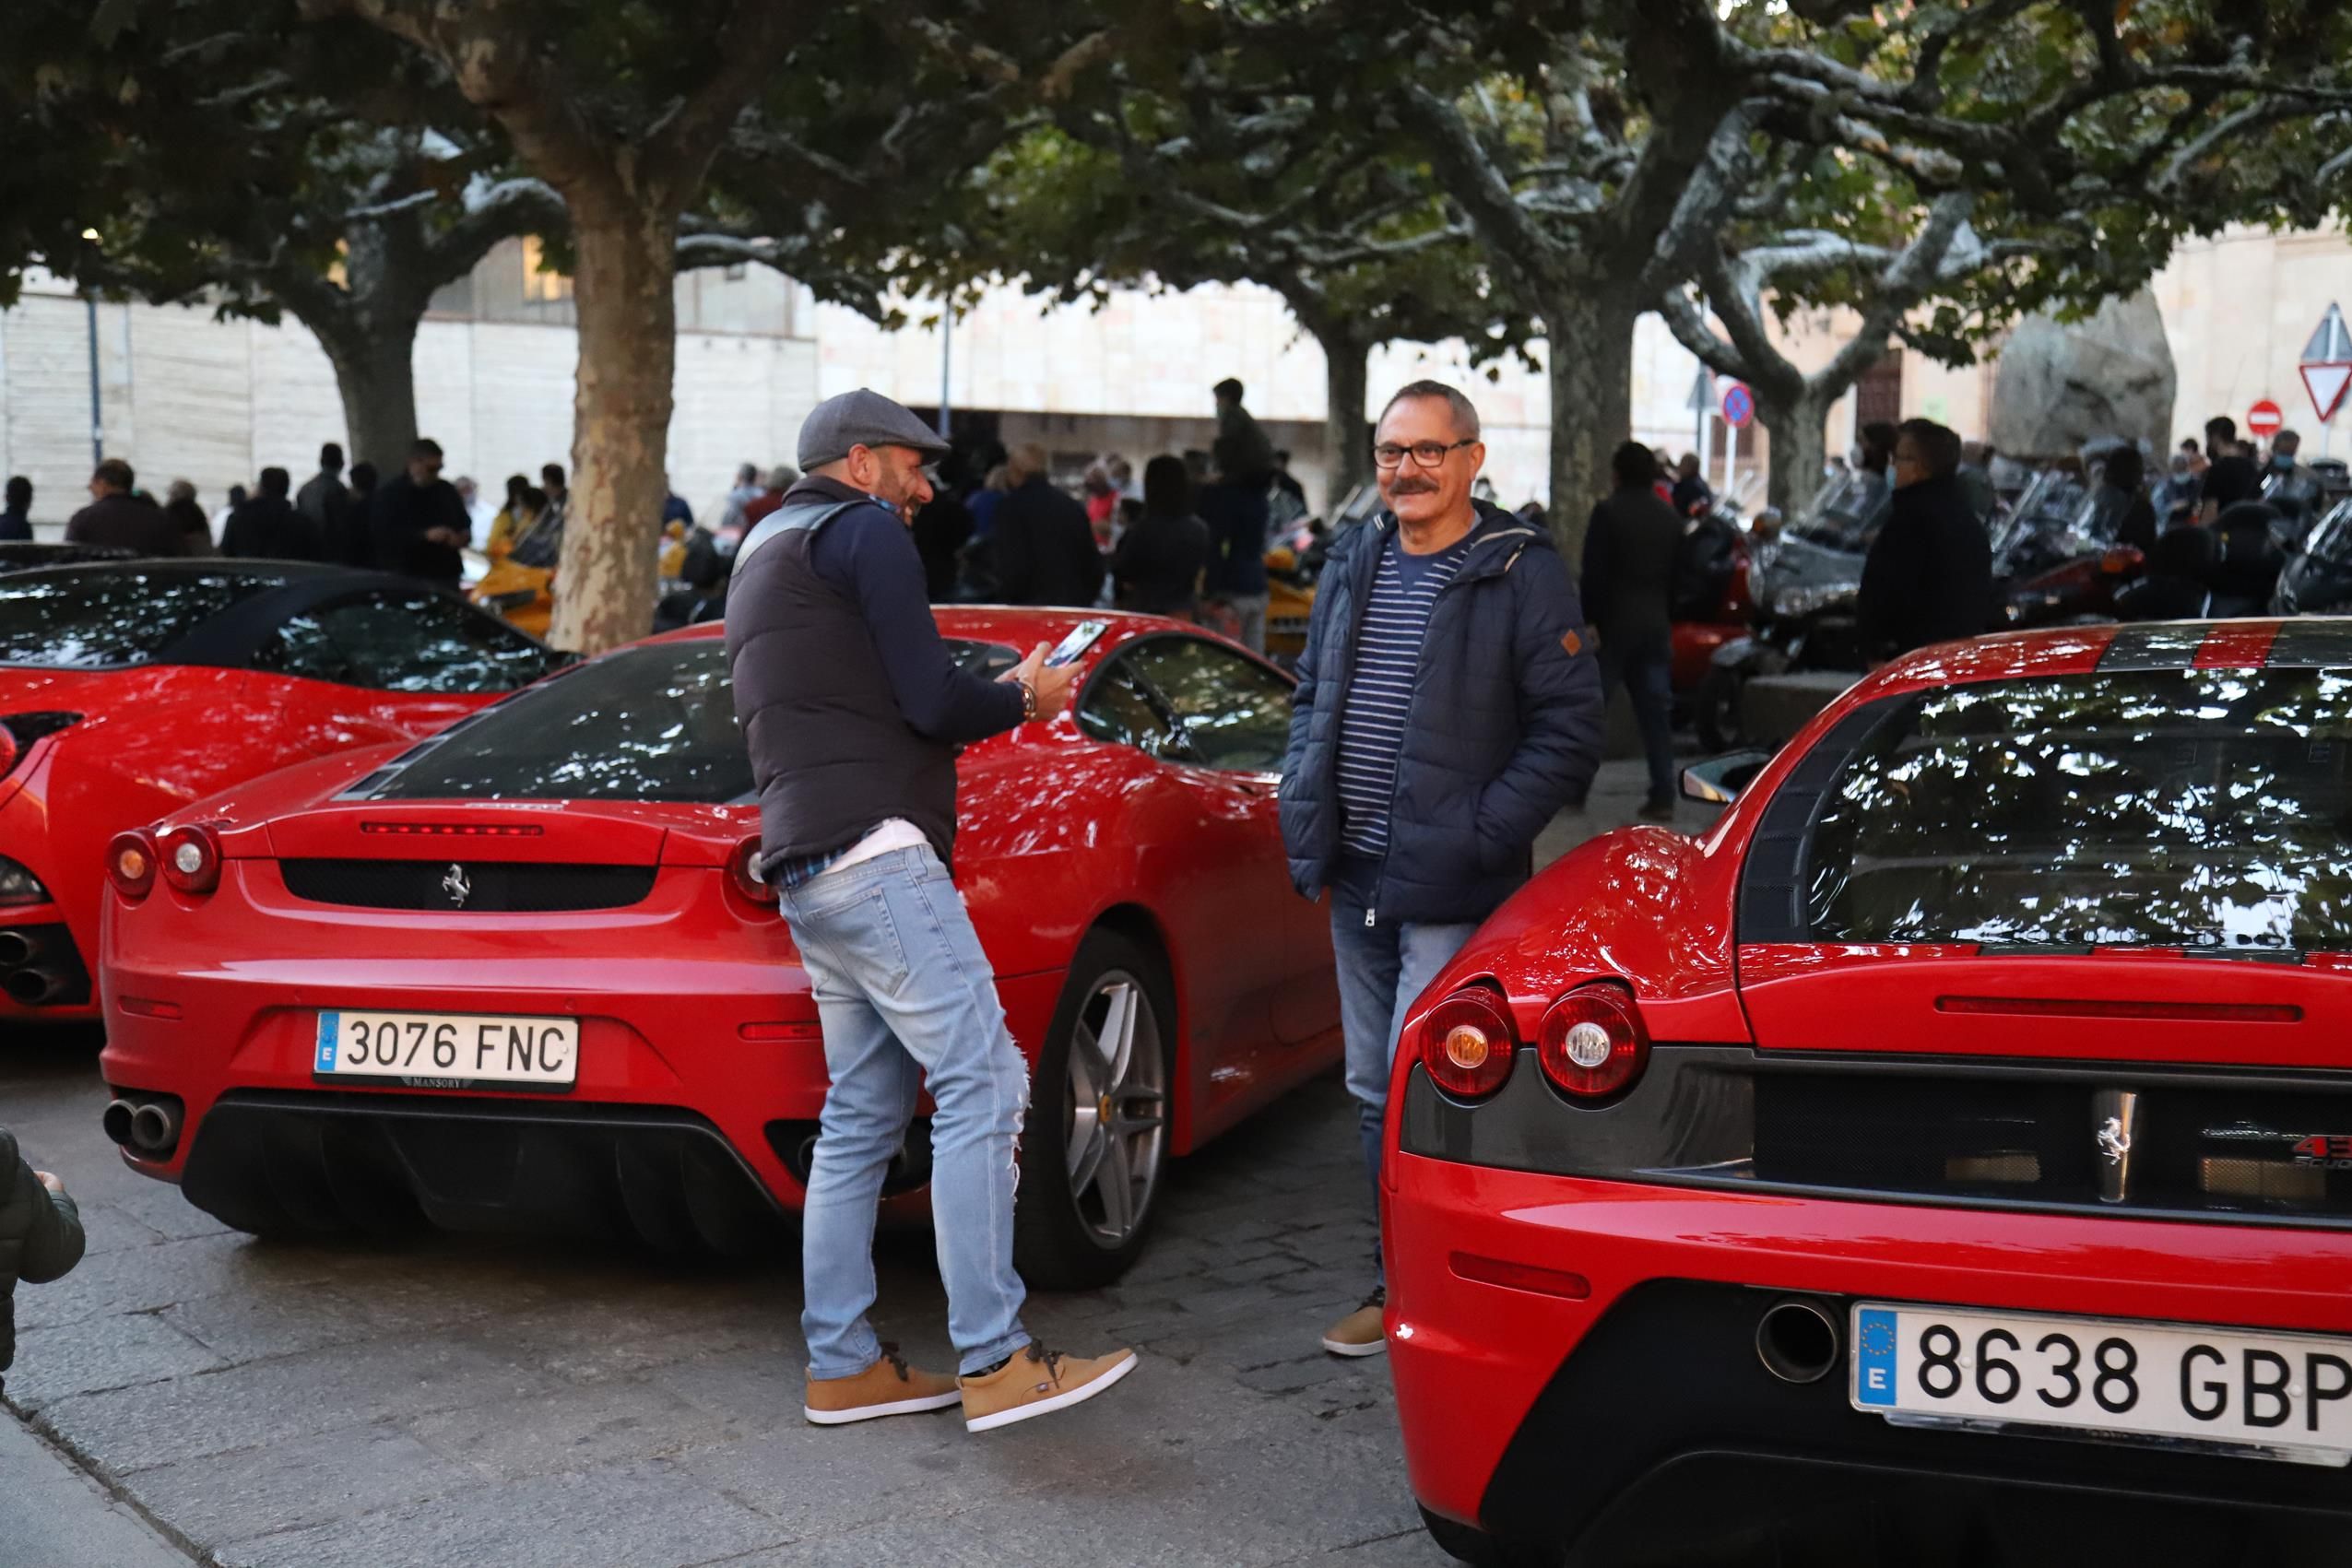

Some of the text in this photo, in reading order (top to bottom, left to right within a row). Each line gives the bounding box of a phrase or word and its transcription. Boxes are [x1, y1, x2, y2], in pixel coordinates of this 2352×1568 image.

[323, 1020, 565, 1072] E 3076 FNC
[412, 1076, 461, 1089] MANSORY
[1868, 1324, 2352, 1432] E 8638 GBP
